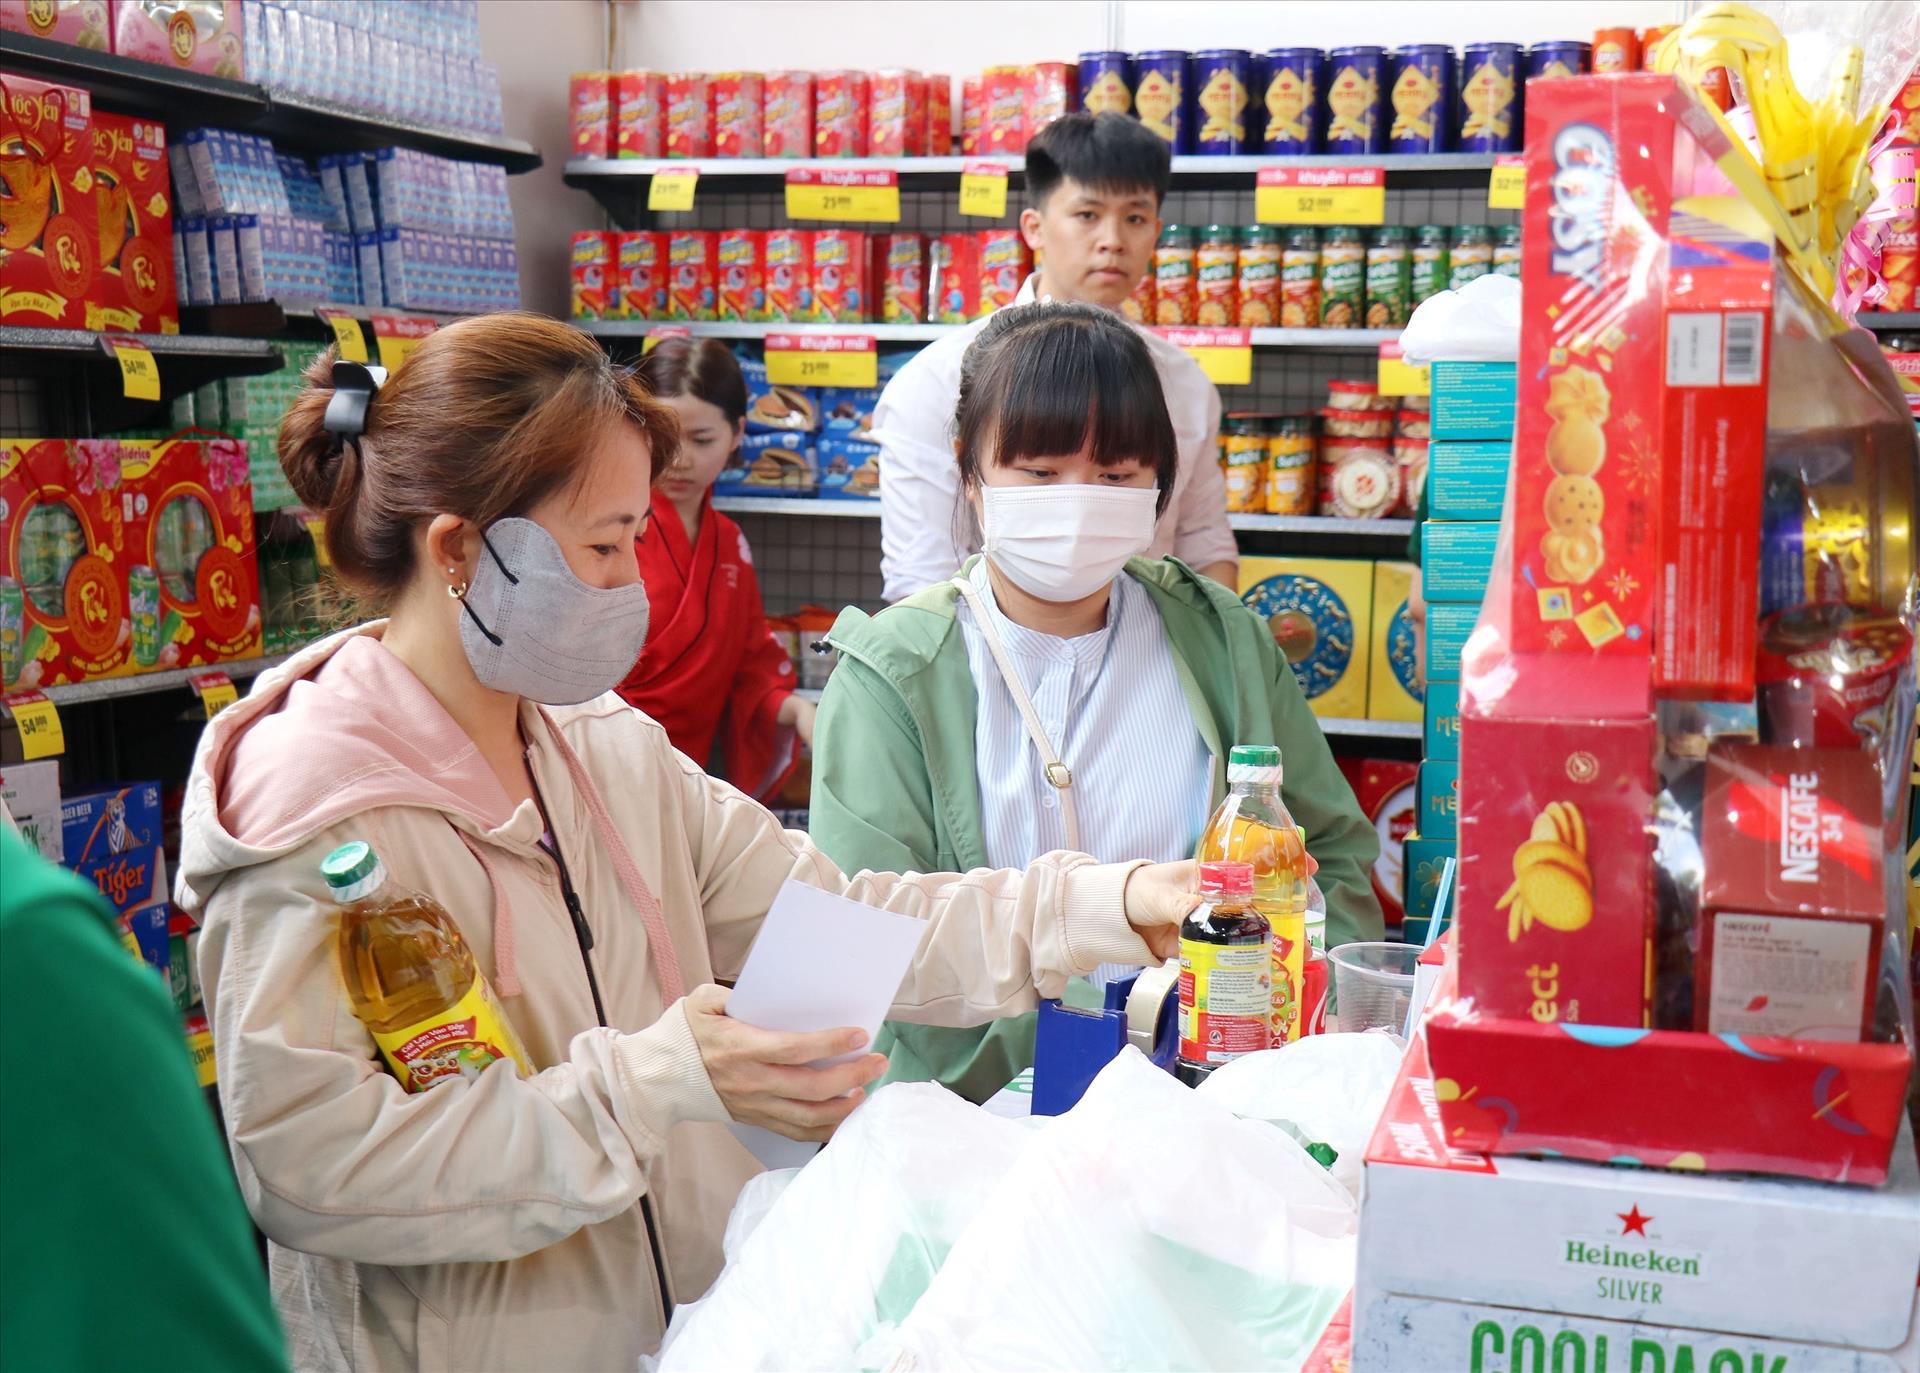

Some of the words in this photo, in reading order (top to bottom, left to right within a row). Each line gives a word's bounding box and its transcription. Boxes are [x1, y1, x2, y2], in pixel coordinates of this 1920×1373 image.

[93, 859, 146, 905] Tiger
[1565, 1239, 1700, 1277] Heineken
[1597, 1275, 1663, 1304] SILVER
